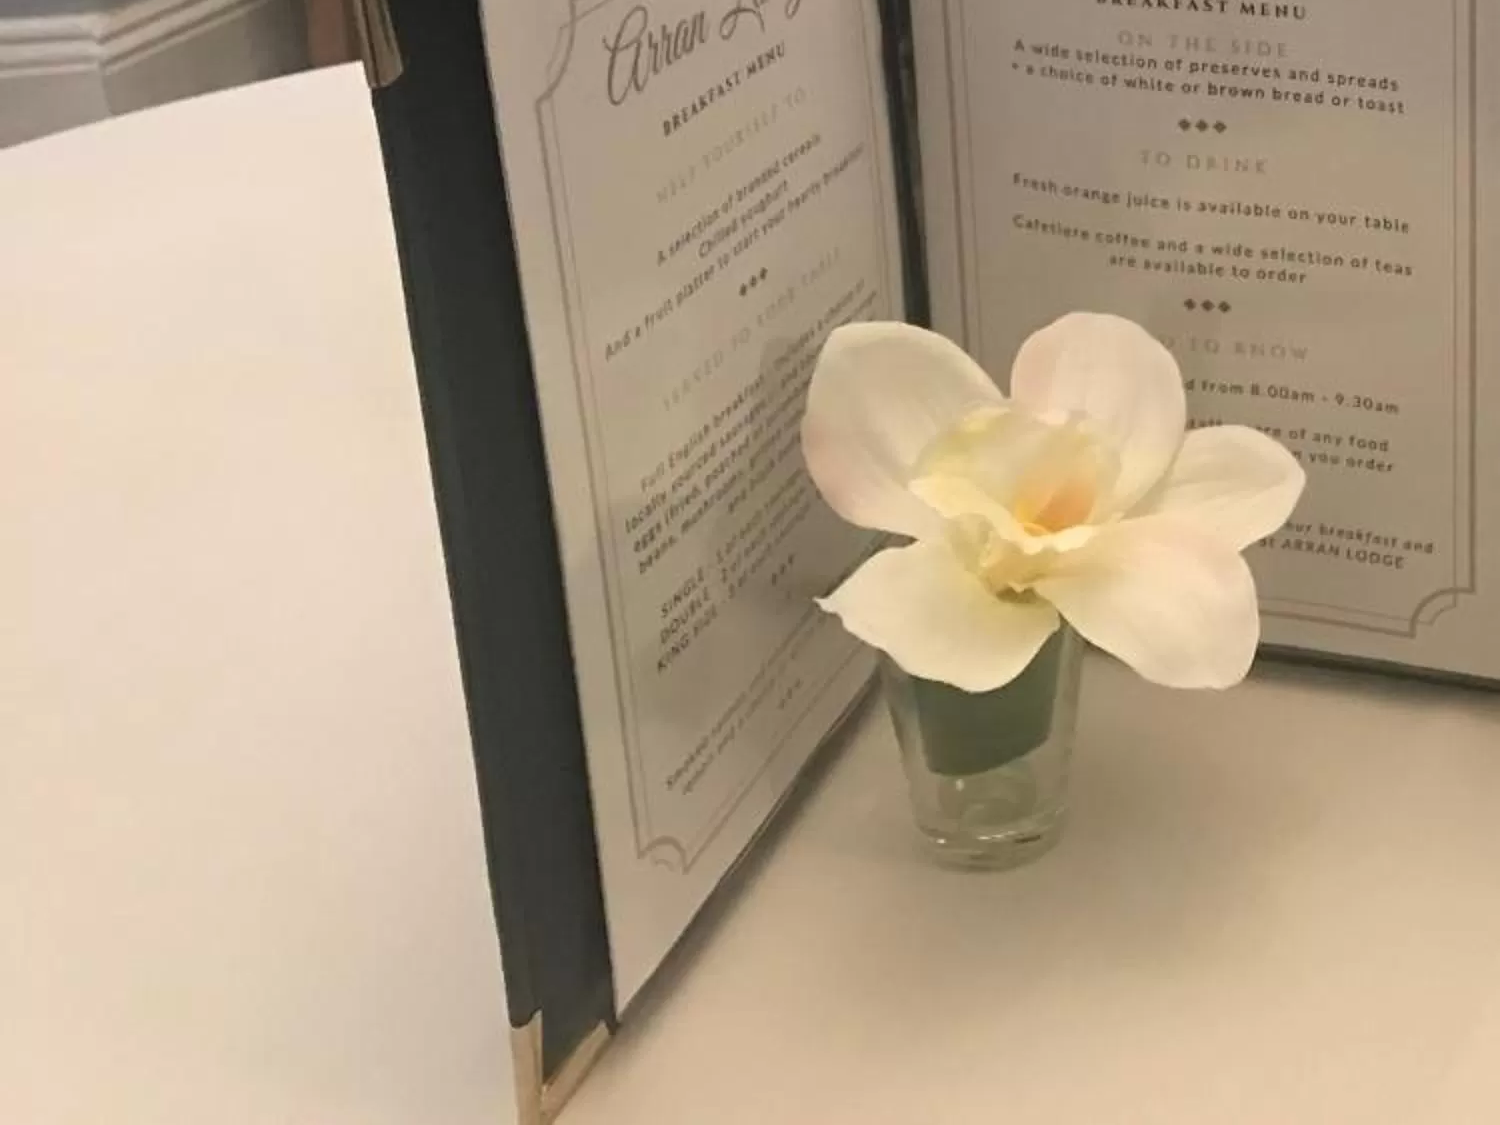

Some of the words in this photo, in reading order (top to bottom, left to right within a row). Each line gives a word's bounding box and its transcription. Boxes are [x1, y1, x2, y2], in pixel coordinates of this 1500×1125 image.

[1240, 0, 1306, 20] MENU
[602, 5, 708, 107] Arran
[1117, 30, 1152, 47] ON
[1168, 34, 1216, 52] THE
[1231, 38, 1288, 58] SIDE
[1014, 39, 1025, 52] A
[1031, 42, 1069, 59] wide
[1075, 48, 1157, 69] selection
[1164, 59, 1183, 71] of
[1189, 61, 1281, 80] preserves
[1287, 68, 1320, 83] and
[1327, 74, 1399, 92] spreads
[663, 72, 739, 135] BREAKFAST
[747, 43, 784, 76] MENU
[1026, 65, 1034, 75] a
[1040, 65, 1094, 85] choice
[1100, 74, 1118, 87] of
[1123, 76, 1174, 93] white
[1181, 82, 1201, 94] or
[1207, 82, 1265, 100] brown
[1272, 86, 1324, 105] bread
[1331, 95, 1350, 107] or
[1358, 97, 1404, 115] toast
[1140, 149, 1171, 167] TO
[1187, 154, 1266, 174] DRINK
[1013, 172, 1057, 194] Fresh
[1061, 185, 1121, 204] orange
[1126, 191, 1170, 210] juice
[1176, 196, 1192, 212] is
[1197, 200, 1281, 219] available
[1287, 208, 1310, 221] on
[1316, 211, 1357, 226] your
[1364, 215, 1409, 235] table
[1095, 231, 1151, 249] coffee
[1157, 239, 1188, 253] and
[1195, 244, 1204, 254] a
[1211, 242, 1254, 258] wide
[1260, 246, 1345, 267] selection
[1350, 256, 1369, 269] of
[1375, 259, 1413, 276] teas
[1109, 255, 1137, 269] are
[1143, 258, 1225, 277] available
[1231, 265, 1250, 279] to
[1255, 267, 1307, 284] order
[1201, 380, 1244, 395] from
[1335, 392, 1399, 415] 9.30am
[1289, 428, 1306, 440] of
[1312, 431, 1342, 447] any
[1349, 430, 1389, 452] food
[1309, 451, 1340, 465] you
[1346, 454, 1394, 473] order
[1281, 538, 1340, 557] ARRAN
[1346, 547, 1405, 570] LODGE
[1319, 523, 1398, 549] breakfast
[1403, 540, 1435, 554] and
